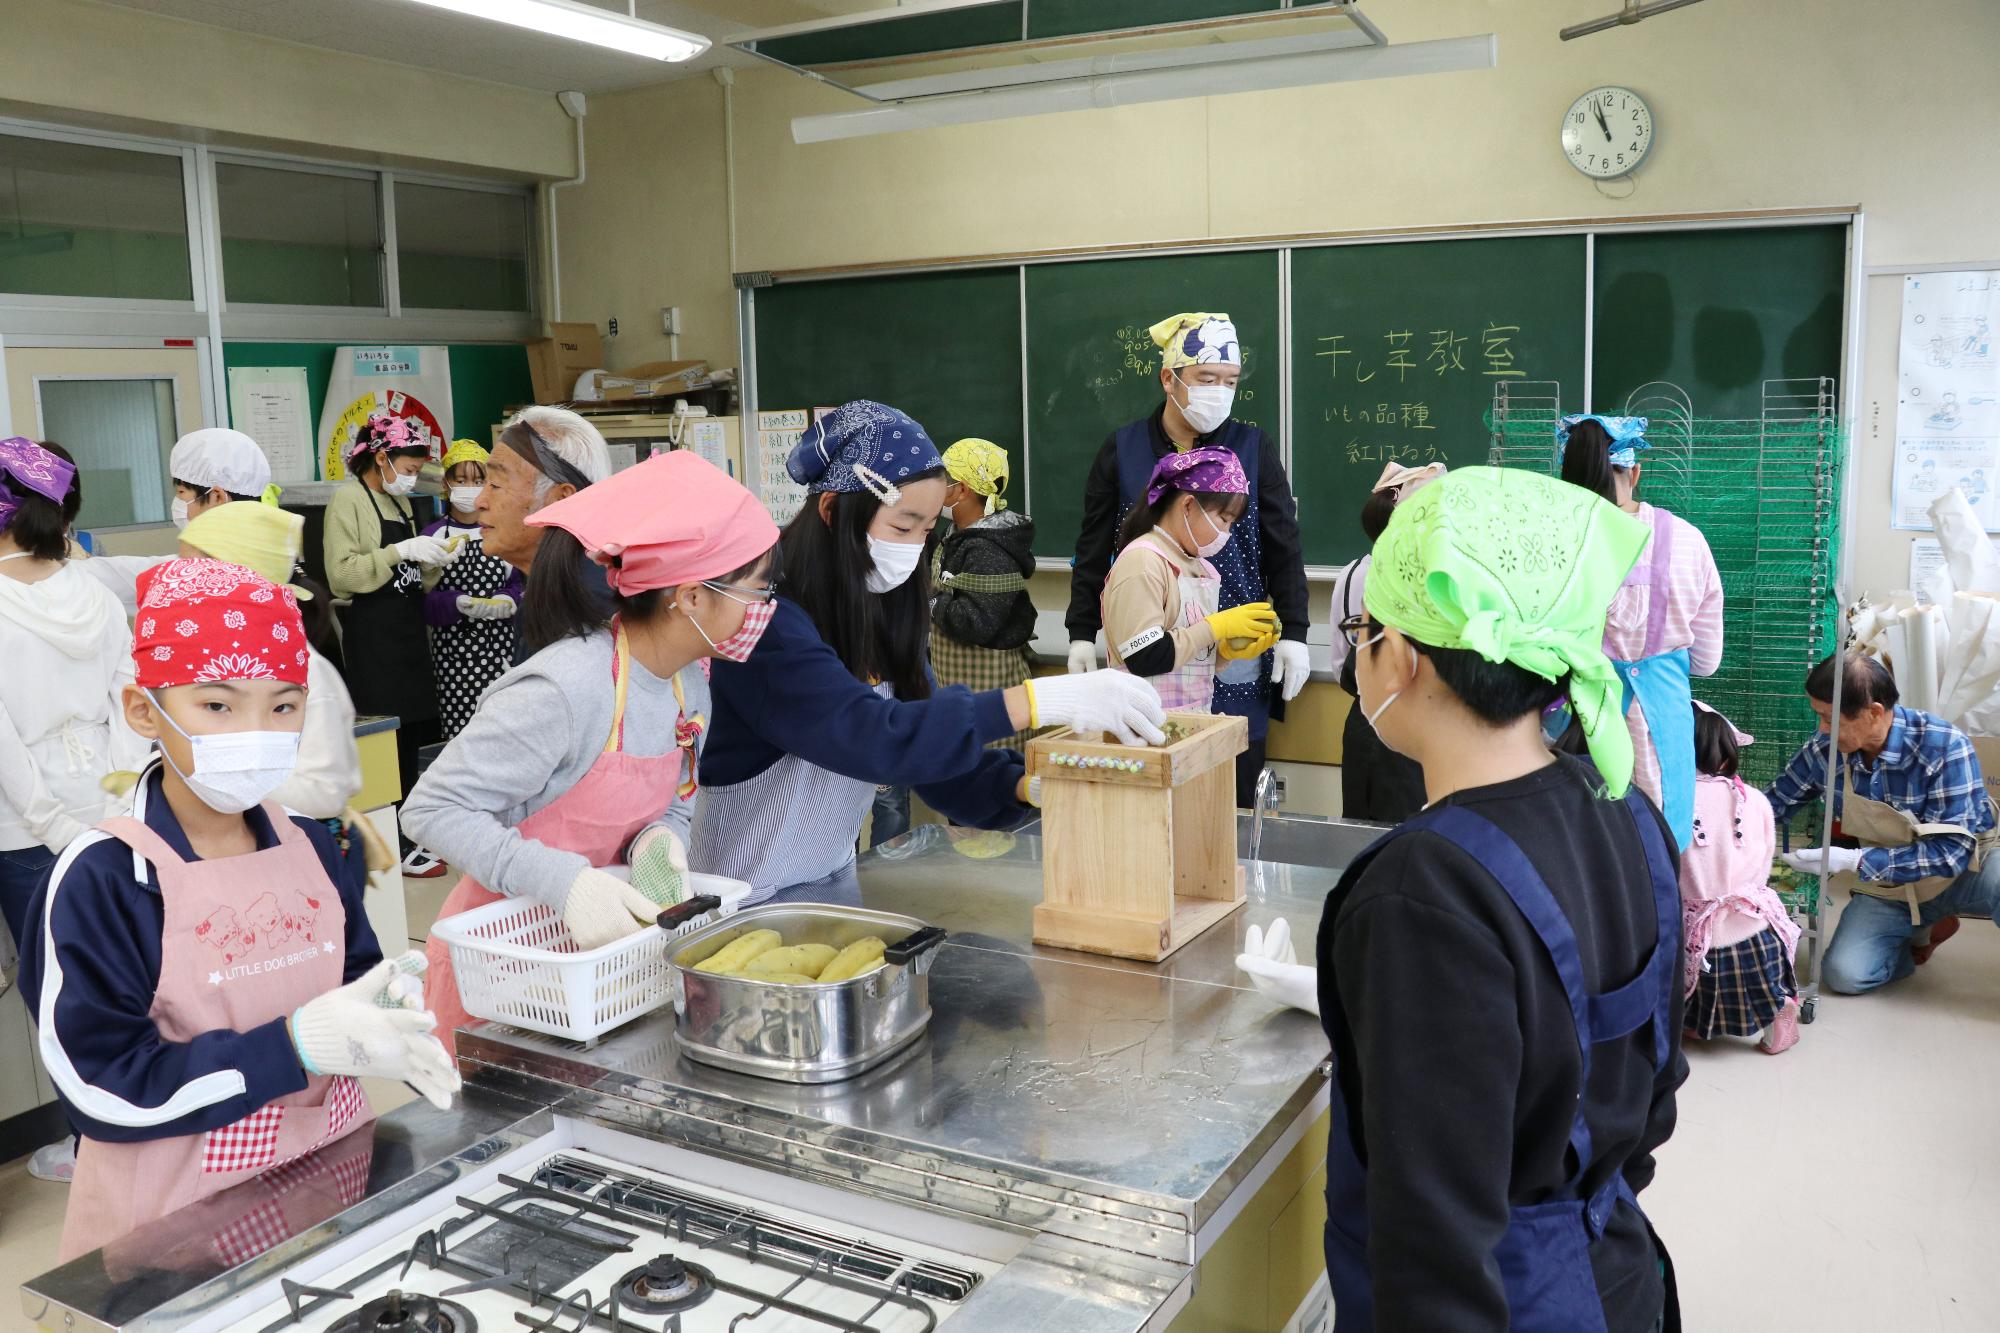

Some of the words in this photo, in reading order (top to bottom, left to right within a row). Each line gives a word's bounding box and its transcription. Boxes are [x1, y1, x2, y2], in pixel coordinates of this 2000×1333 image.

[1588, 100, 1596, 112] 11
[1603, 95, 1614, 106] 12
[1622, 98, 1626, 110] 1
[1575, 113, 1585, 124] 10
[1632, 109, 1639, 121] 2
[1572, 128, 1578, 140] 9
[1635, 125, 1643, 136] 3
[1575, 144, 1582, 155] 8
[1629, 142, 1638, 153] 4
[1588, 154, 1595, 165] 7
[1602, 158, 1609, 169] 6
[1616, 153, 1624, 165] 5
[357, 352, 390, 360] いろいろな
[1315, 321, 1527, 383] 干し芋教室
[1325, 401, 1437, 429] いもの品種
[1346, 437, 1449, 464] 紅はるか
[1130, 634, 1150, 650] FOCUS
[225, 962, 262, 981] LITTLE
[263, 957, 287, 972] DOG
